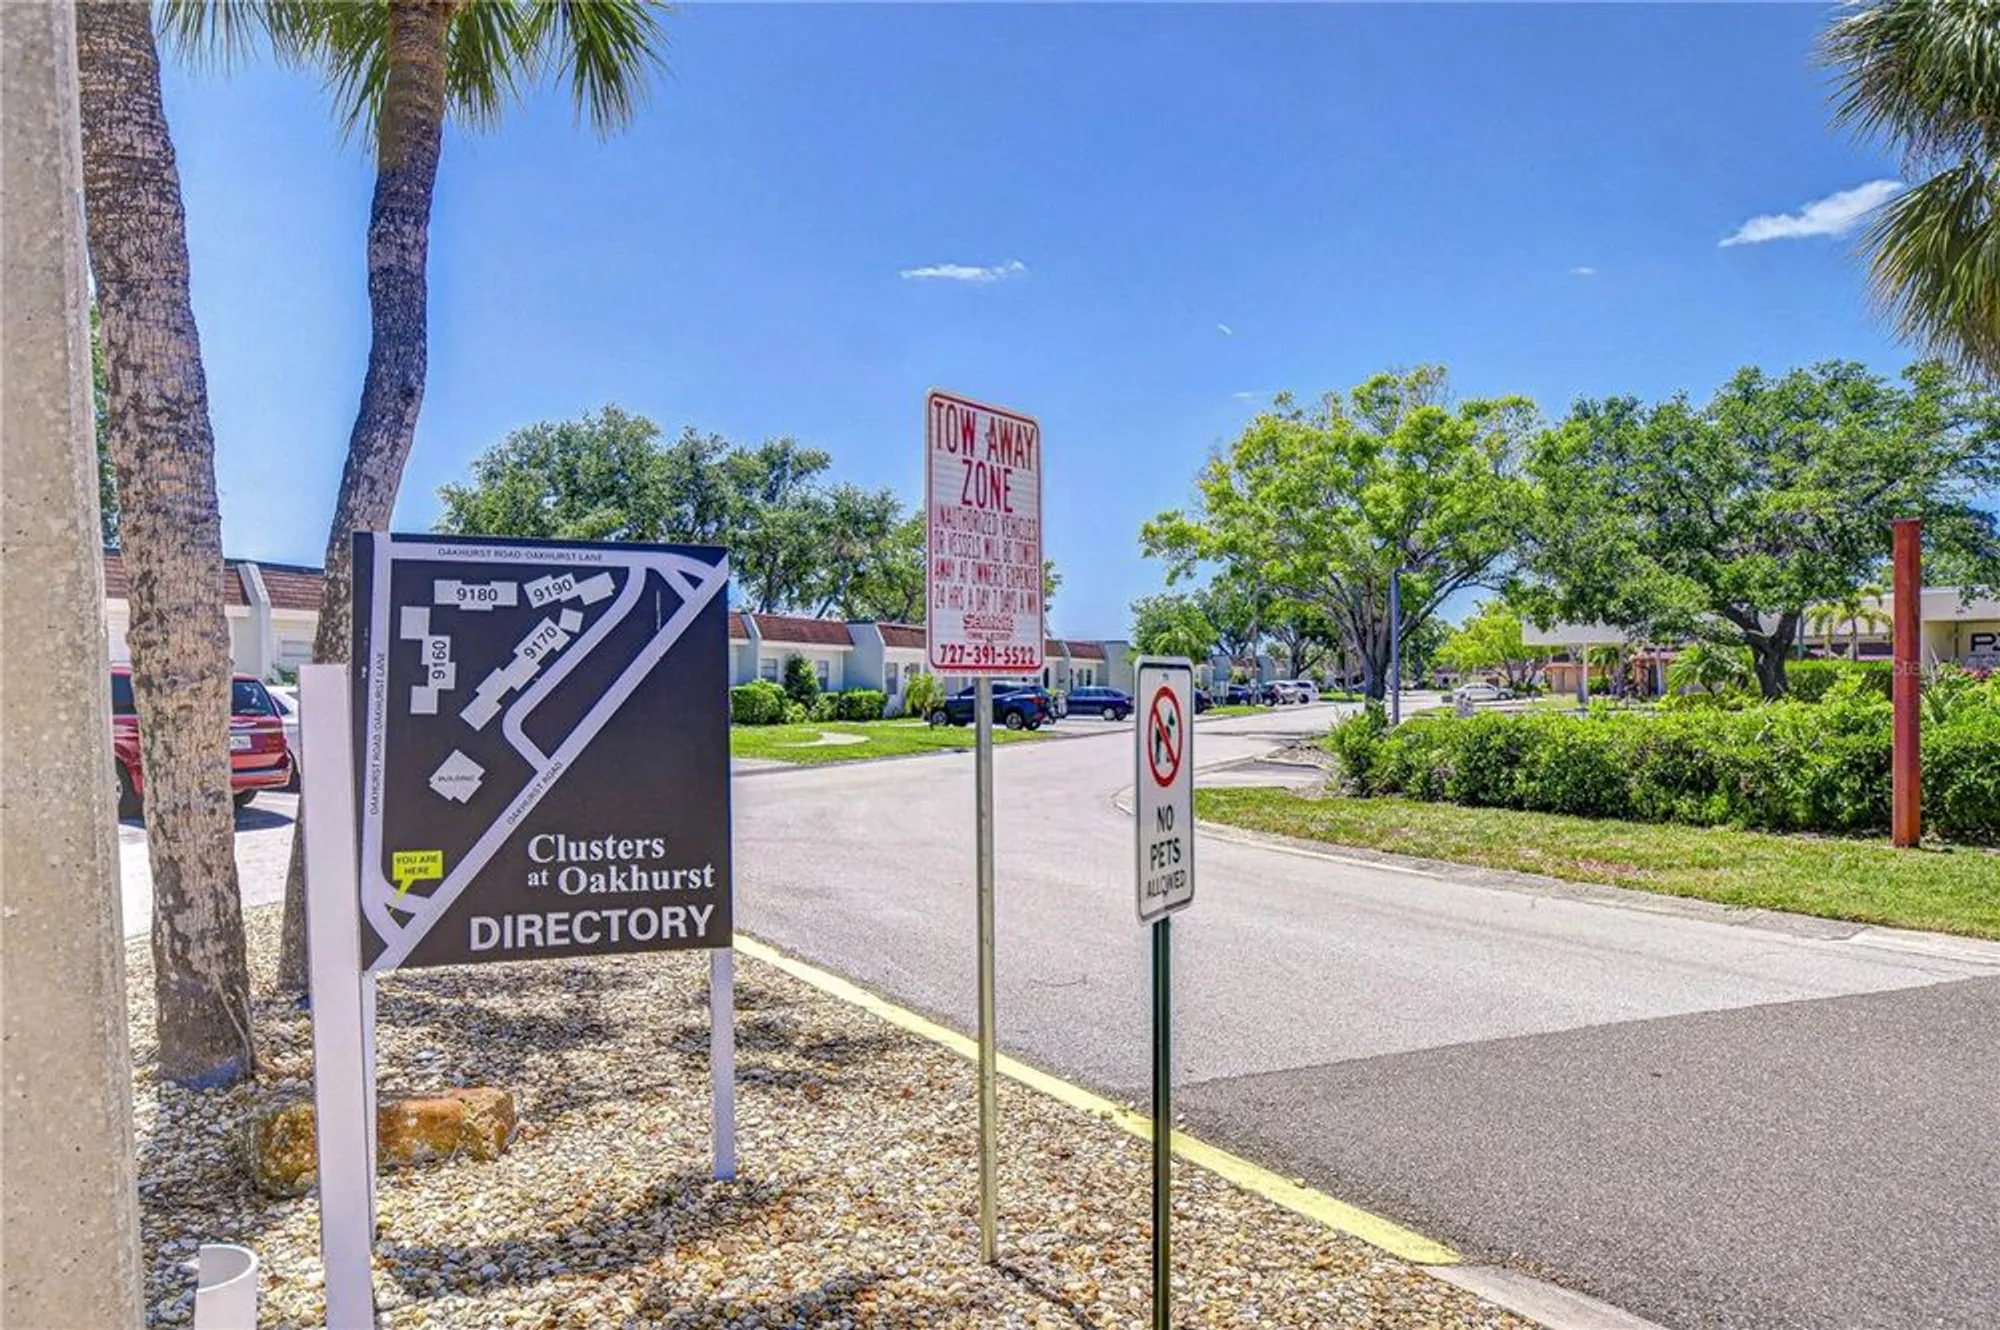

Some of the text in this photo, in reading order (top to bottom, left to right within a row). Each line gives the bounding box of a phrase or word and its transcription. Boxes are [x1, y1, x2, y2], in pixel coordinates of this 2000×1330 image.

[934, 401, 1035, 471] TOW AWAY
[961, 459, 1013, 513] ZONE
[438, 548, 491, 558] OAKHURST
[578, 553, 602, 562] LANE
[456, 588, 498, 601] 9180
[533, 579, 573, 601] 9190
[523, 626, 558, 659] 9170
[939, 644, 1035, 665] 727-391-5522
[432, 640, 447, 680] 9160
[506, 761, 563, 825] OAKHURST ROAD
[1156, 804, 1175, 833] NO
[396, 854, 438, 865] YOU ARE
[528, 834, 666, 863] Clusters
[1150, 837, 1181, 871] PETS
[404, 866, 429, 875] HERE
[528, 863, 715, 895] at Oakhurst
[1147, 869, 1187, 897] ALLOWED
[470, 904, 715, 951] DIRECTORY
